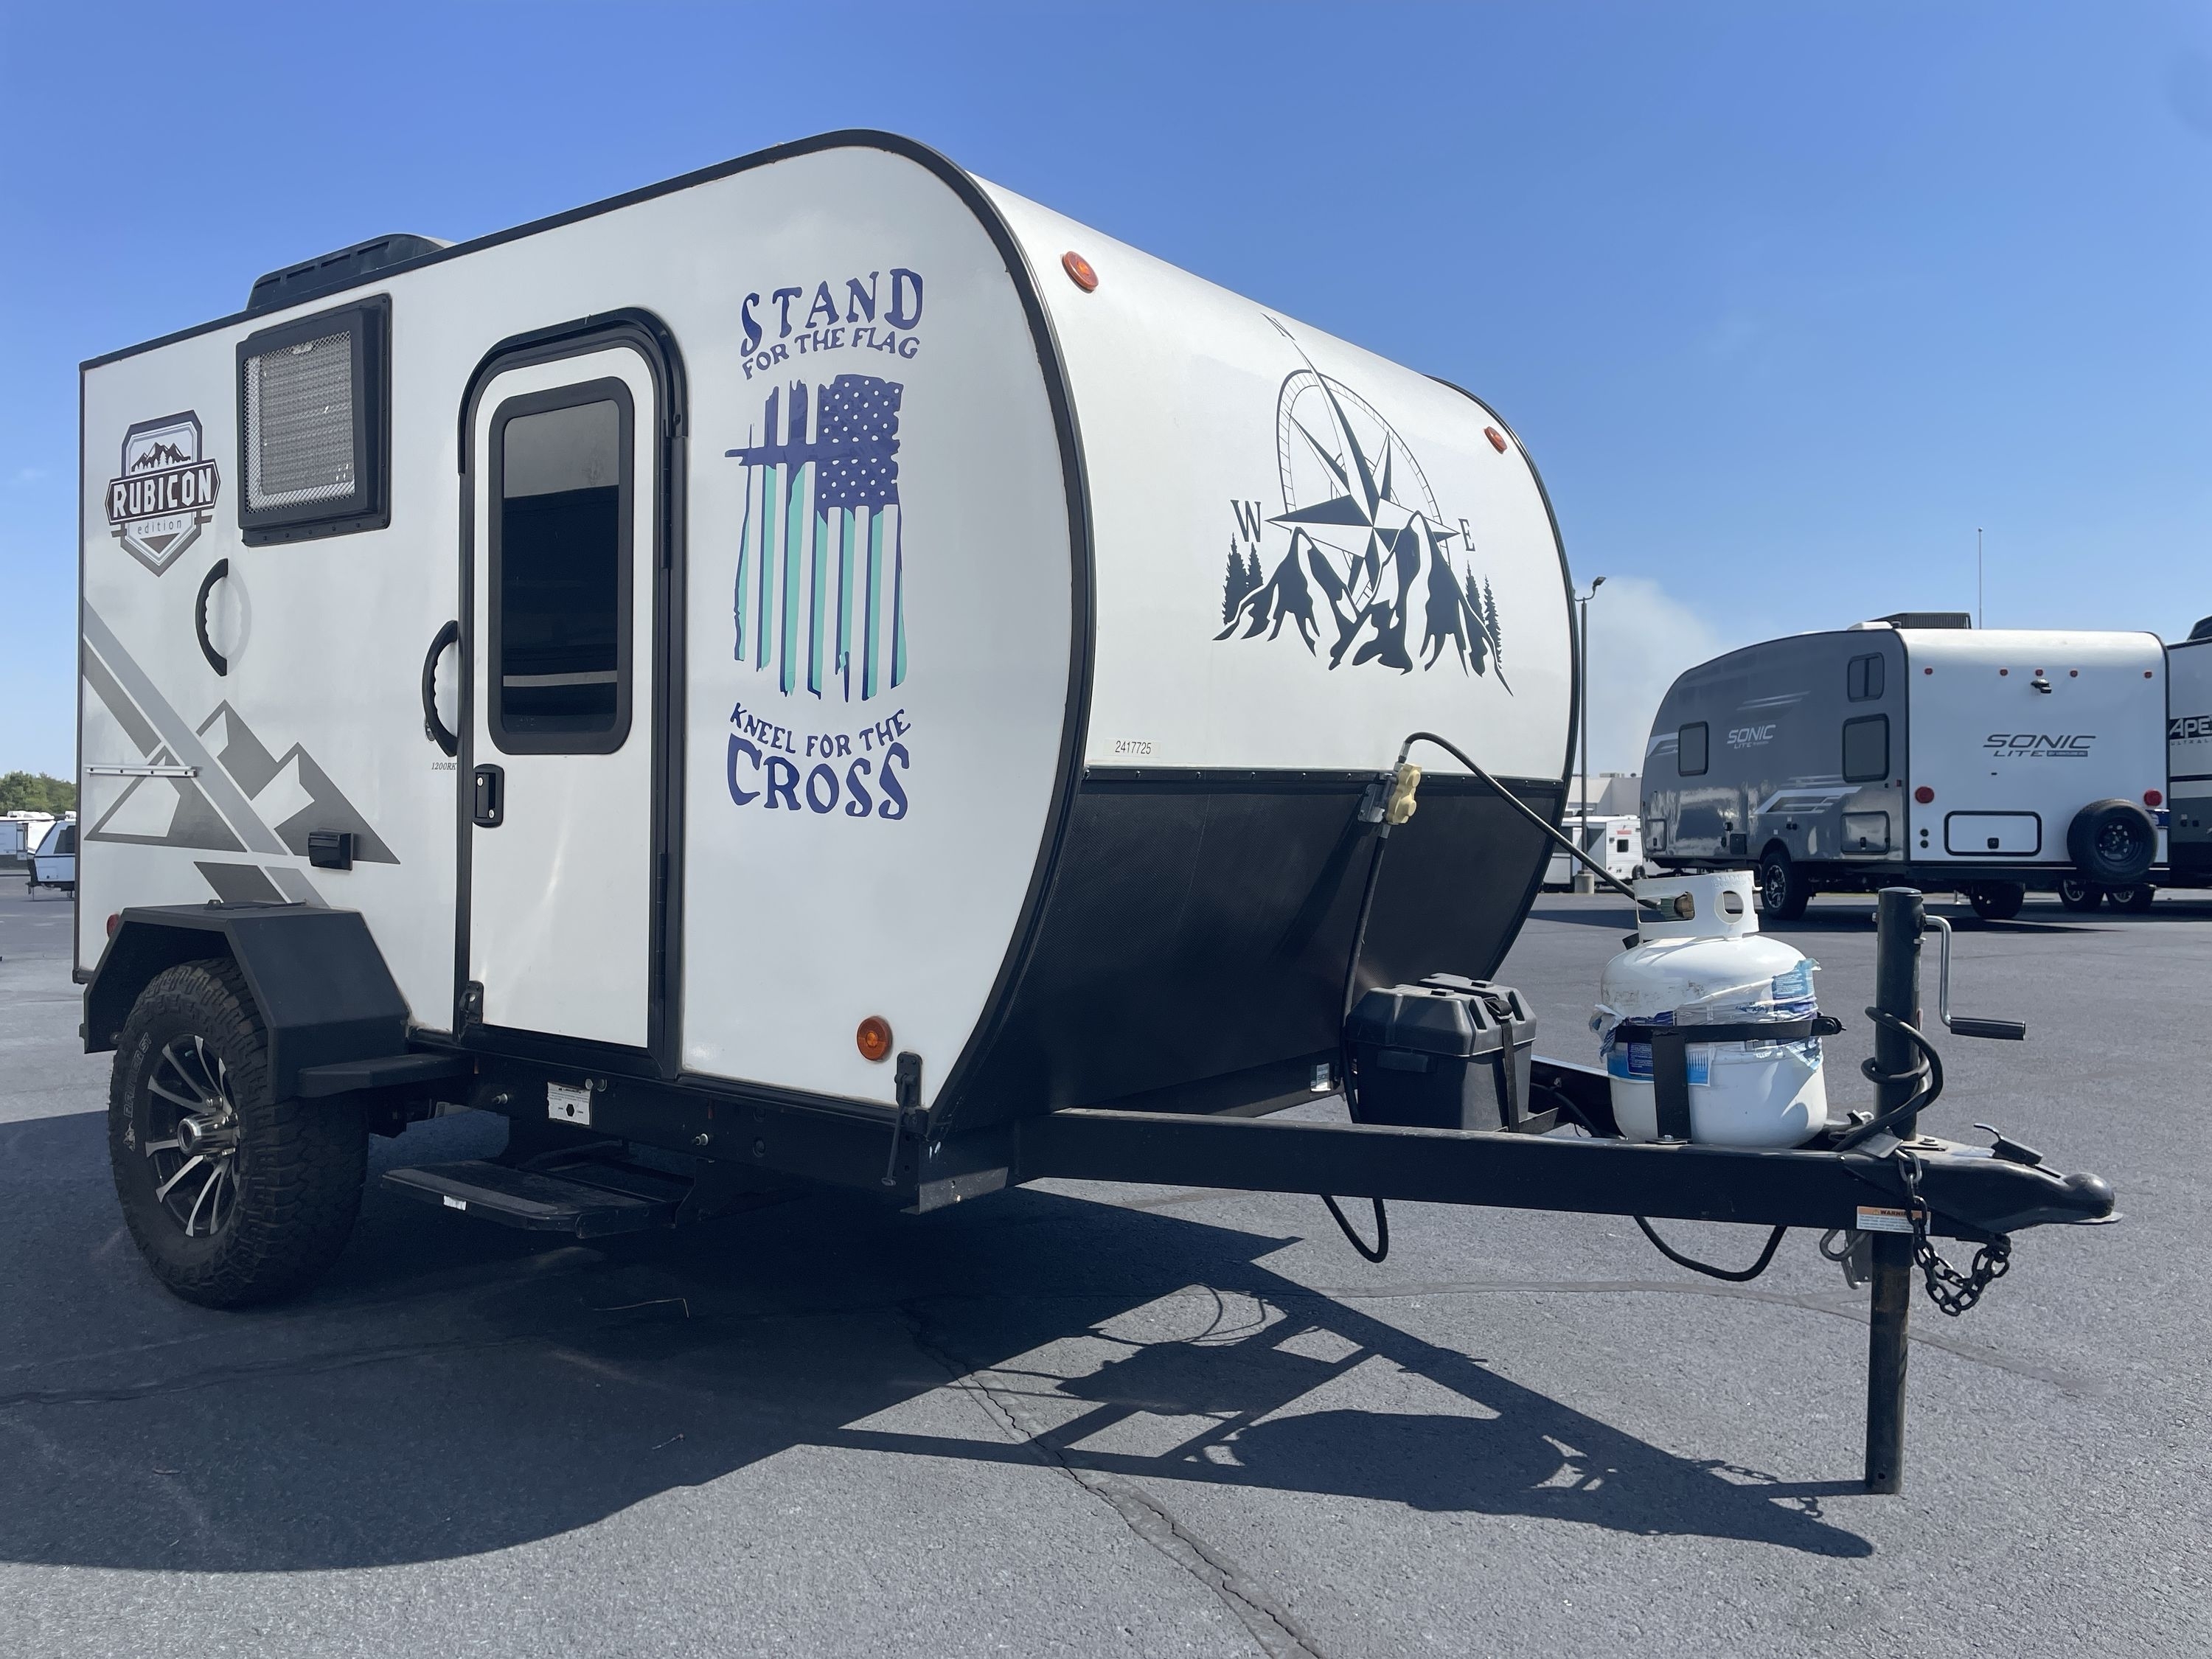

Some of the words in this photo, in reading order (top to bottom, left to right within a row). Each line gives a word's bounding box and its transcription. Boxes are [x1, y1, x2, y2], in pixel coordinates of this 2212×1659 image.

[740, 268, 923, 358] STAND
[742, 343, 790, 380] FOR
[794, 327, 846, 355] THE
[851, 327, 920, 360] FLAG
[113, 467, 212, 518] RUBICON
[137, 518, 182, 535] edition
[1230, 500, 1262, 543] W
[1459, 518, 1476, 552] E
[729, 702, 796, 754] KNEEL
[806, 734, 852, 759] FOR
[859, 708, 911, 751] THE
[1115, 740, 1152, 754] 2417725
[1727, 724, 1776, 744] SONIC
[1983, 734, 2096, 748] SONIC
[2169, 717, 2212, 739] APE
[726, 732, 911, 821] CROSS
